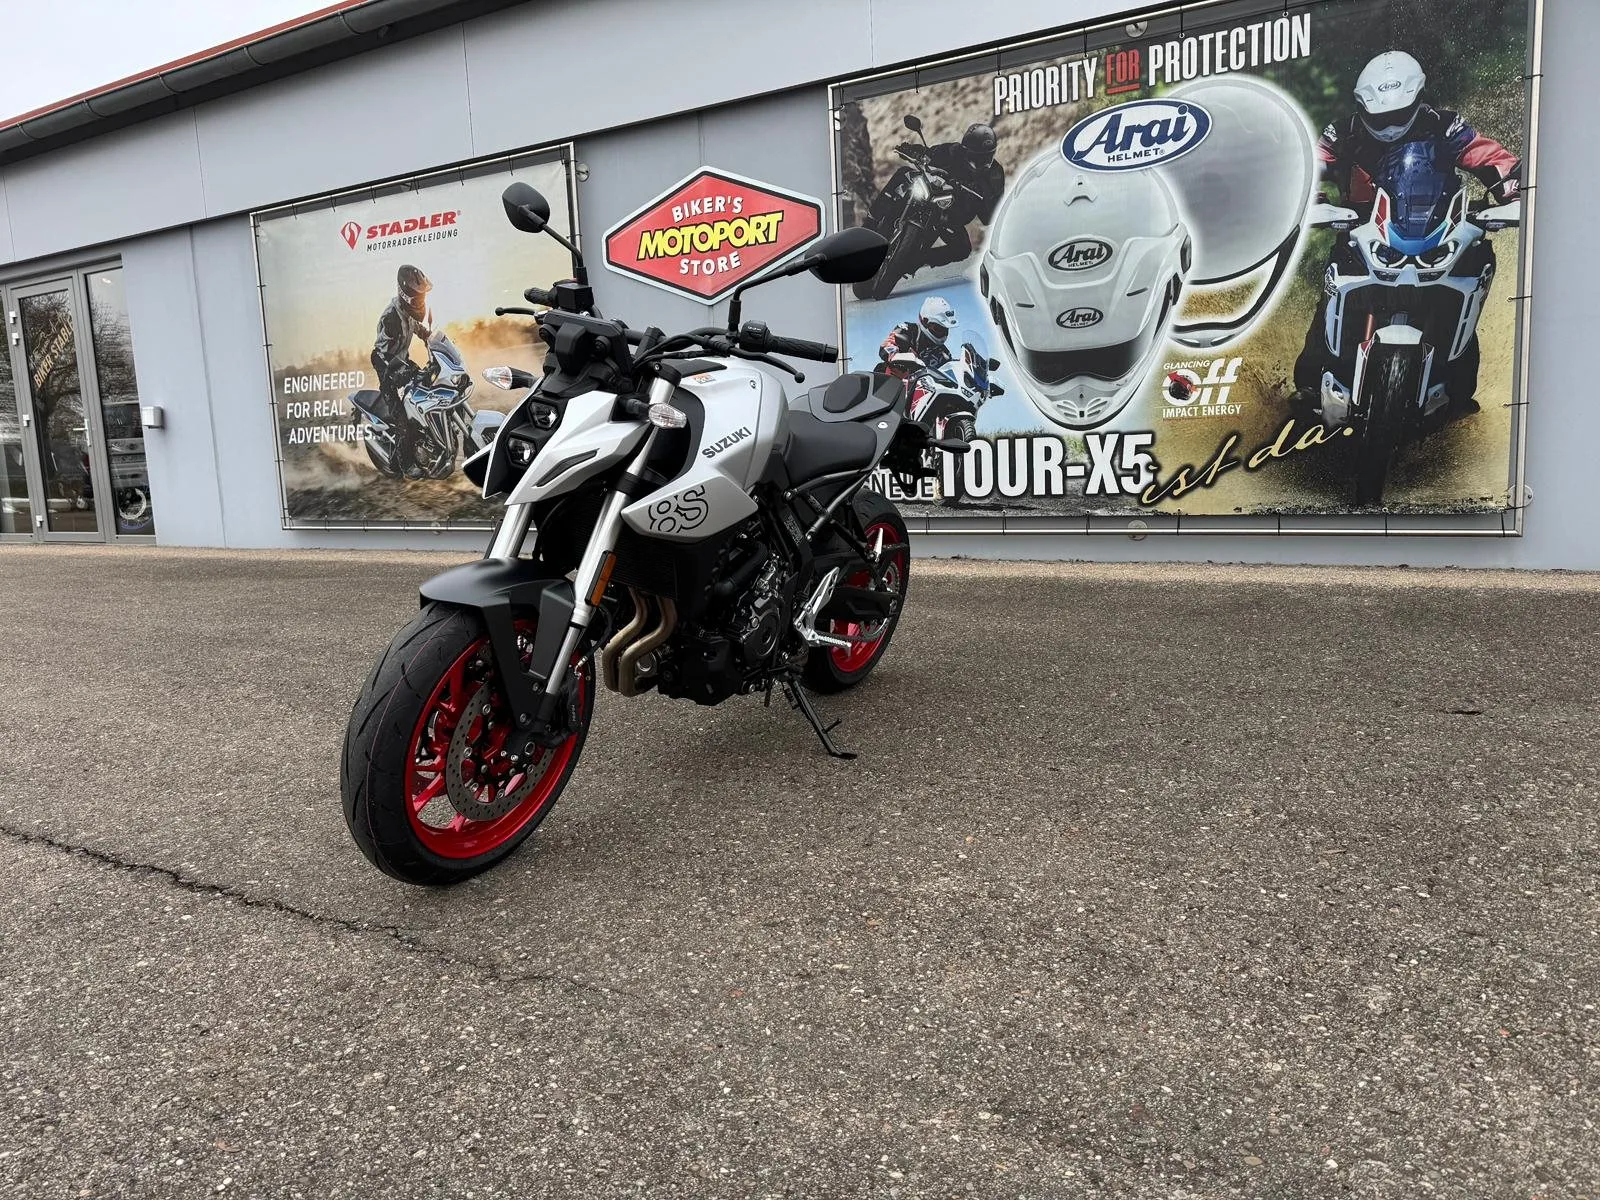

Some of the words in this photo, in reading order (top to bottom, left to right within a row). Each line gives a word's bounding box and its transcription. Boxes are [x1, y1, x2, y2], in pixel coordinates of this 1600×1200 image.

[994, 56, 1098, 116] PRIORITY
[1106, 50, 1141, 86] FOR
[1148, 13, 1312, 87] PROTECTION
[1073, 103, 1192, 161] Arai
[671, 195, 744, 224] BIKER'S
[366, 211, 457, 239] STADLER
[636, 210, 785, 261] MOTOPORT
[366, 228, 459, 252] MOTORRADBEKLEIDUNG
[679, 251, 742, 276] STORE
[1053, 243, 1105, 265] Arai
[1061, 309, 1099, 325] Arai
[33, 354, 54, 388] BIKER
[1163, 359, 1211, 370] GLANCING
[284, 370, 366, 394] ENGINEERED
[286, 401, 310, 419] FOR
[313, 399, 347, 417] REAL
[1162, 406, 1199, 418] IMPACT
[1202, 404, 1242, 417] ENERGY
[288, 423, 376, 445] ADVENTURES.
[701, 425, 753, 459] SUZUKI
[935, 433, 1155, 497] TOUR-X5
